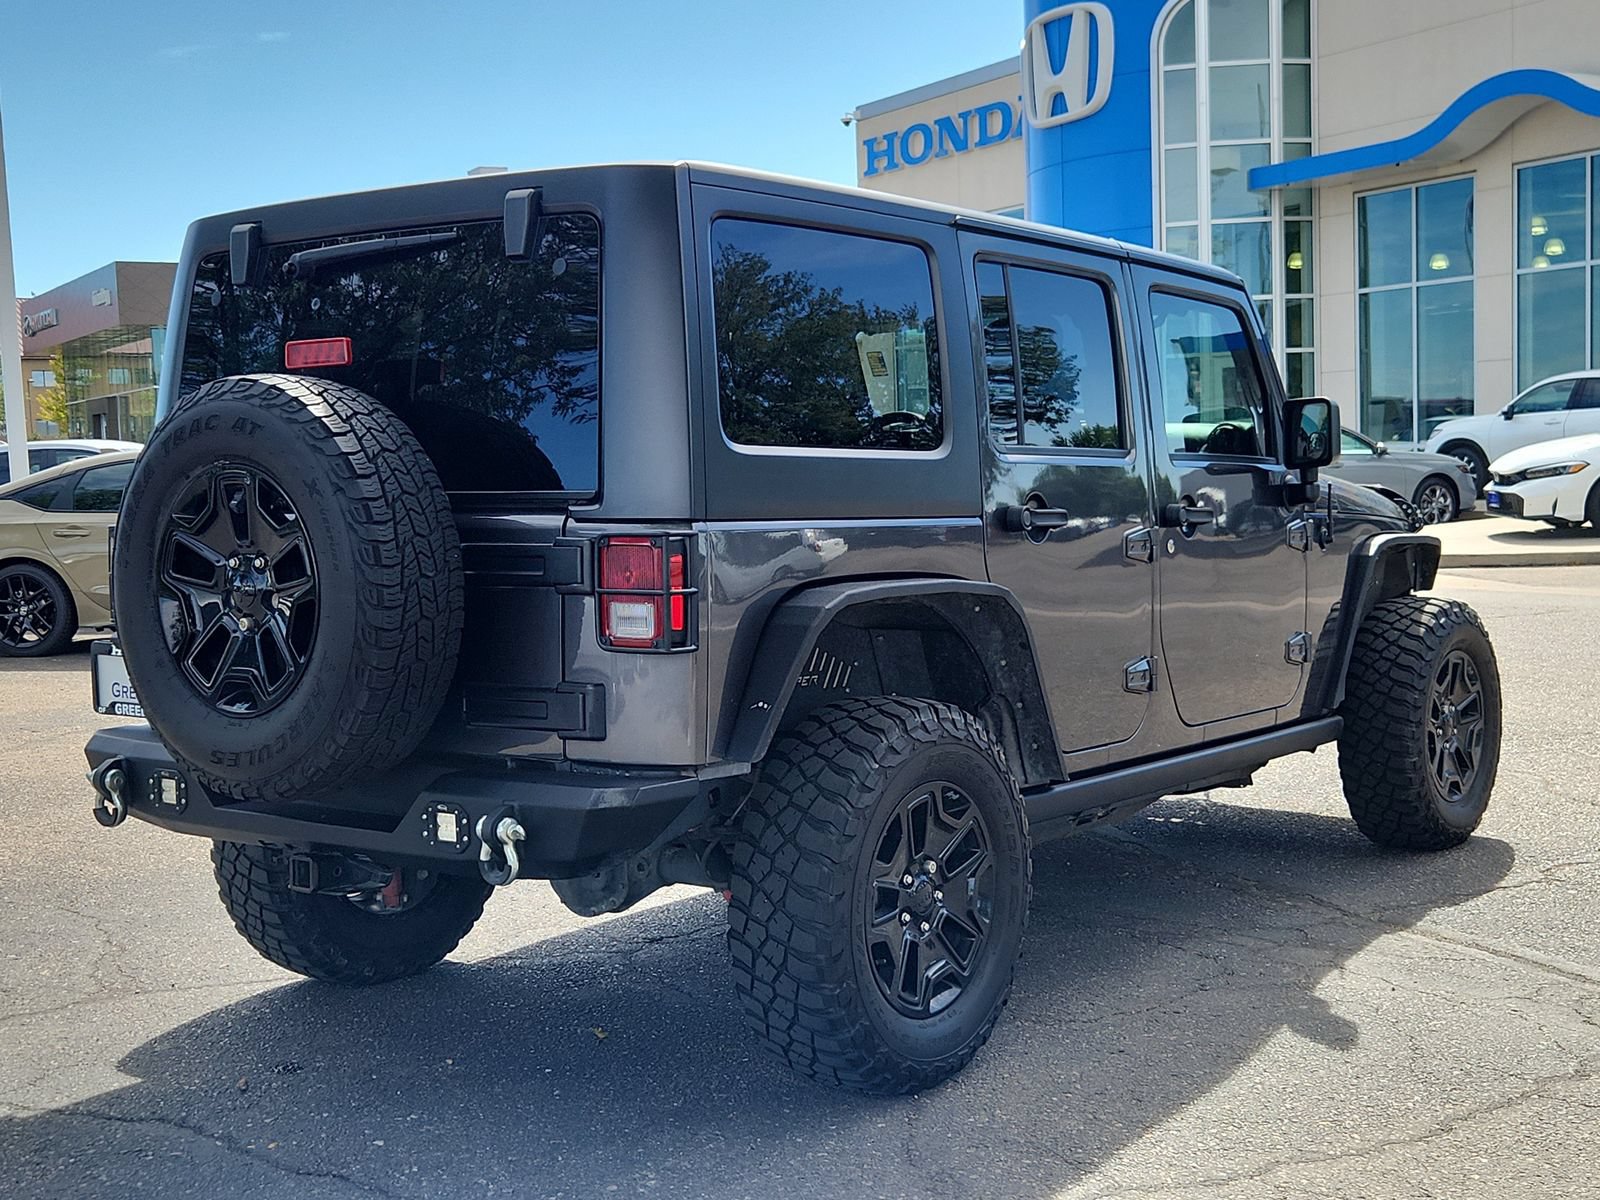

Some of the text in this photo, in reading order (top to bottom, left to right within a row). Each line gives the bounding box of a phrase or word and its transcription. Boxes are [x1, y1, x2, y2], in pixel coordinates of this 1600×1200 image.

[161, 413, 266, 457] TRAC AT
[111, 681, 137, 700] GRE
